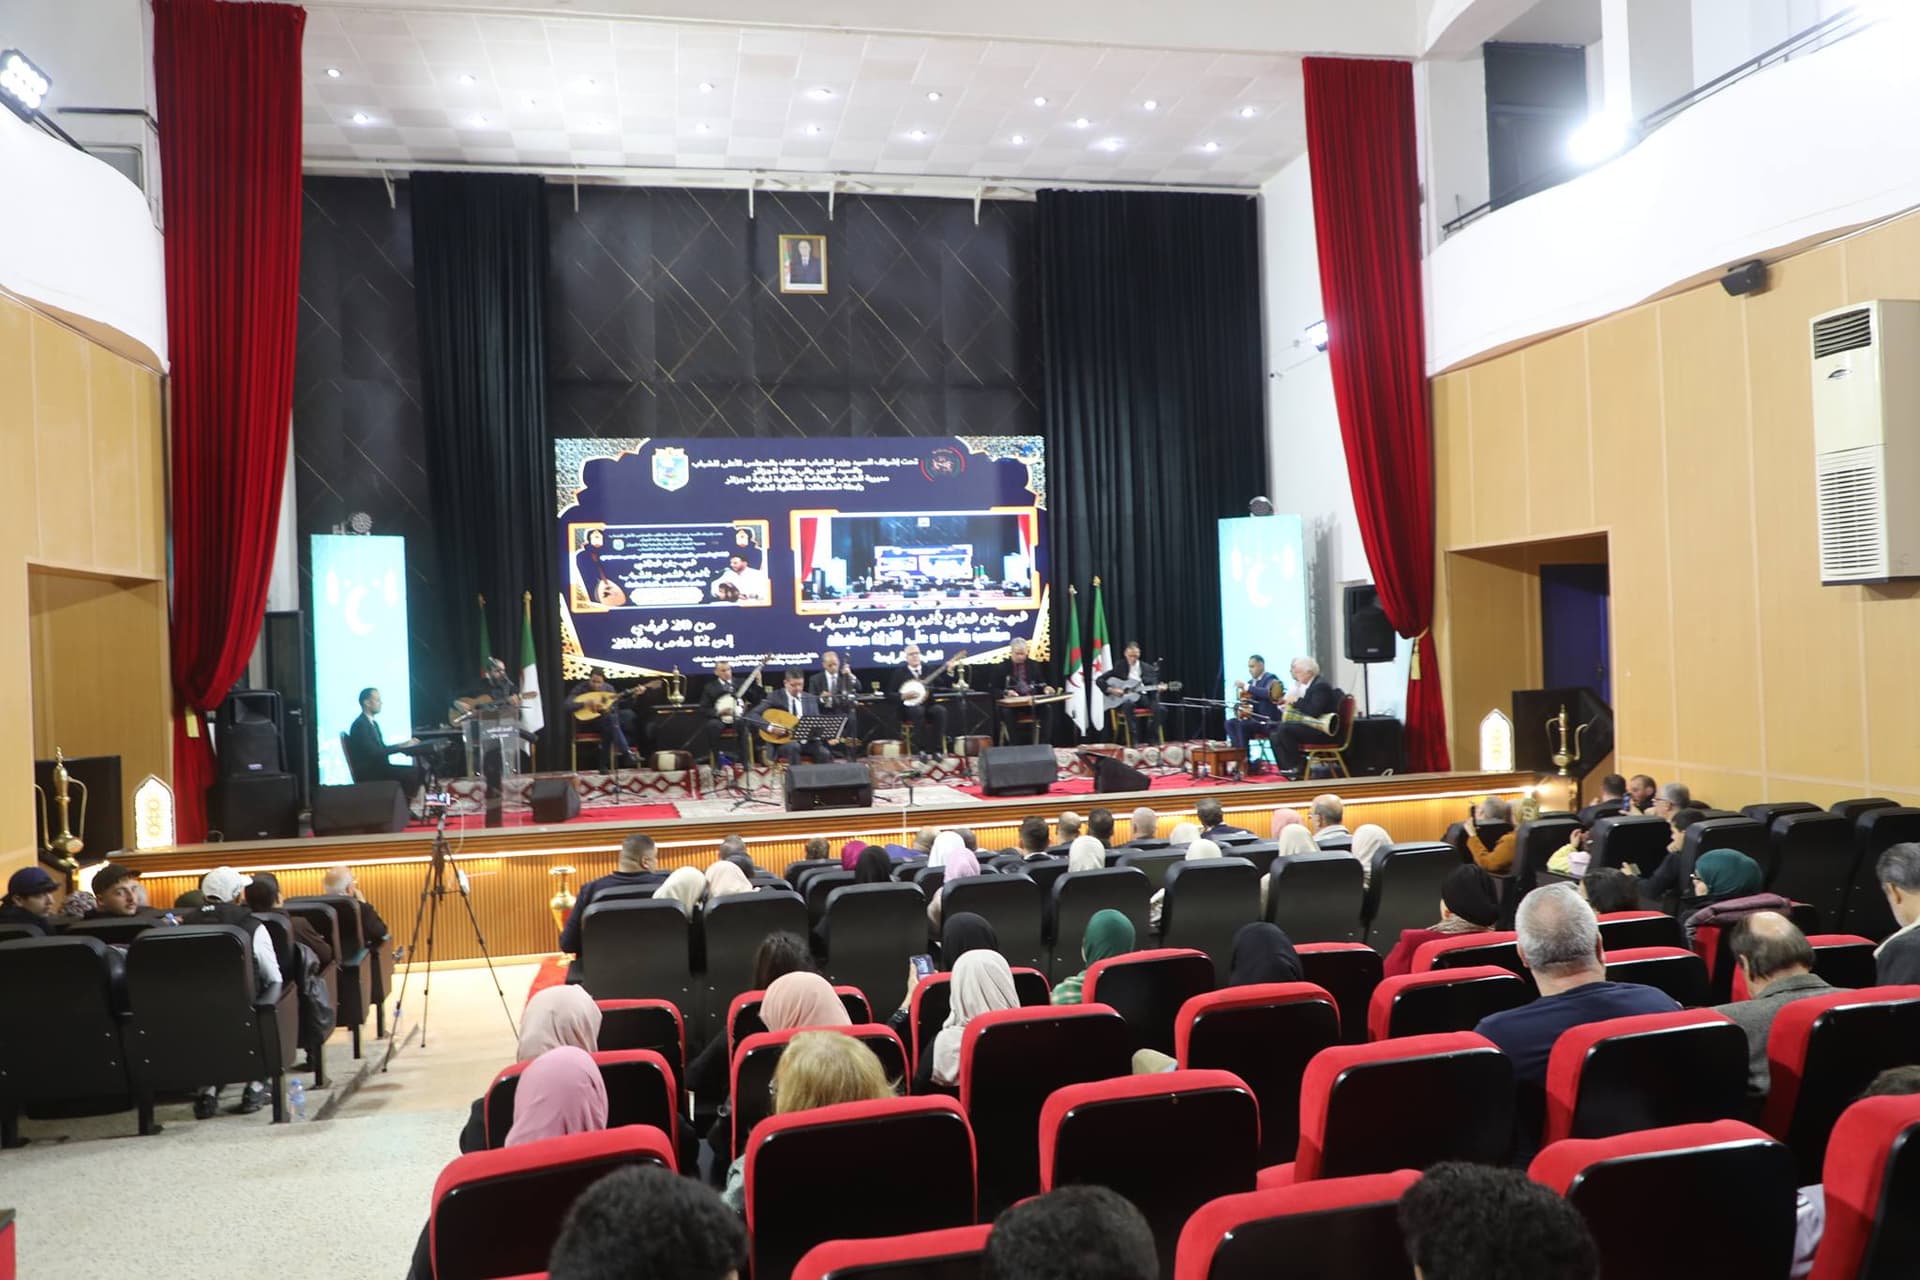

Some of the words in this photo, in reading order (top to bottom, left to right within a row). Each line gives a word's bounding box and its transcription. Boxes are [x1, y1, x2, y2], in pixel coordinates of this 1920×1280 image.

[807, 458, 834, 467] الشباب
[980, 610, 1028, 627] المهرجان
[694, 621, 716, 633] من
[654, 635, 693, 651] مارس
[711, 633, 734, 649] إلى
